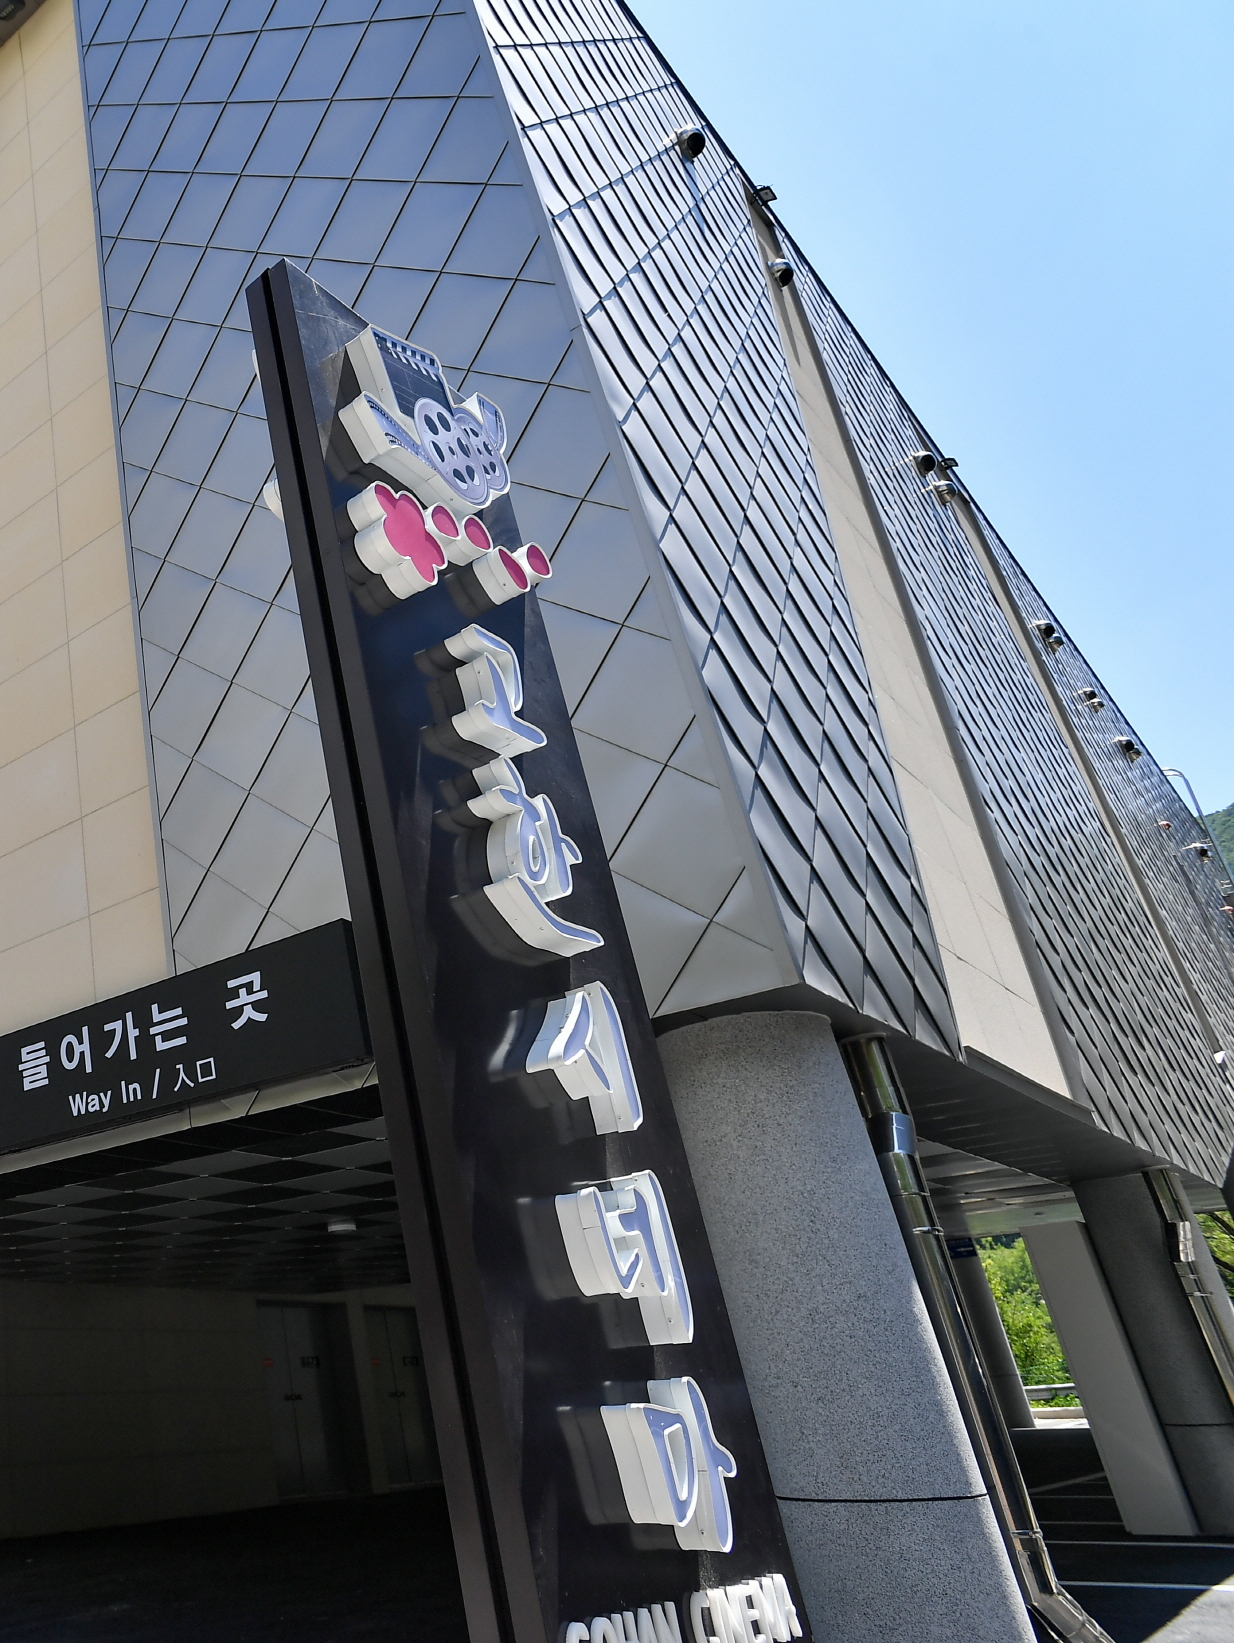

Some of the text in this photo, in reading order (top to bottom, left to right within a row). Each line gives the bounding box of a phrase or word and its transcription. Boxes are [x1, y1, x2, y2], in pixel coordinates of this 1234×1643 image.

[18, 971, 269, 1091] 들어가는 곳
[68, 1090, 112, 1117] Way
[121, 1080, 143, 1104] In
[173, 1057, 217, 1092] 入口
[690, 1573, 803, 1643] CINEMA
